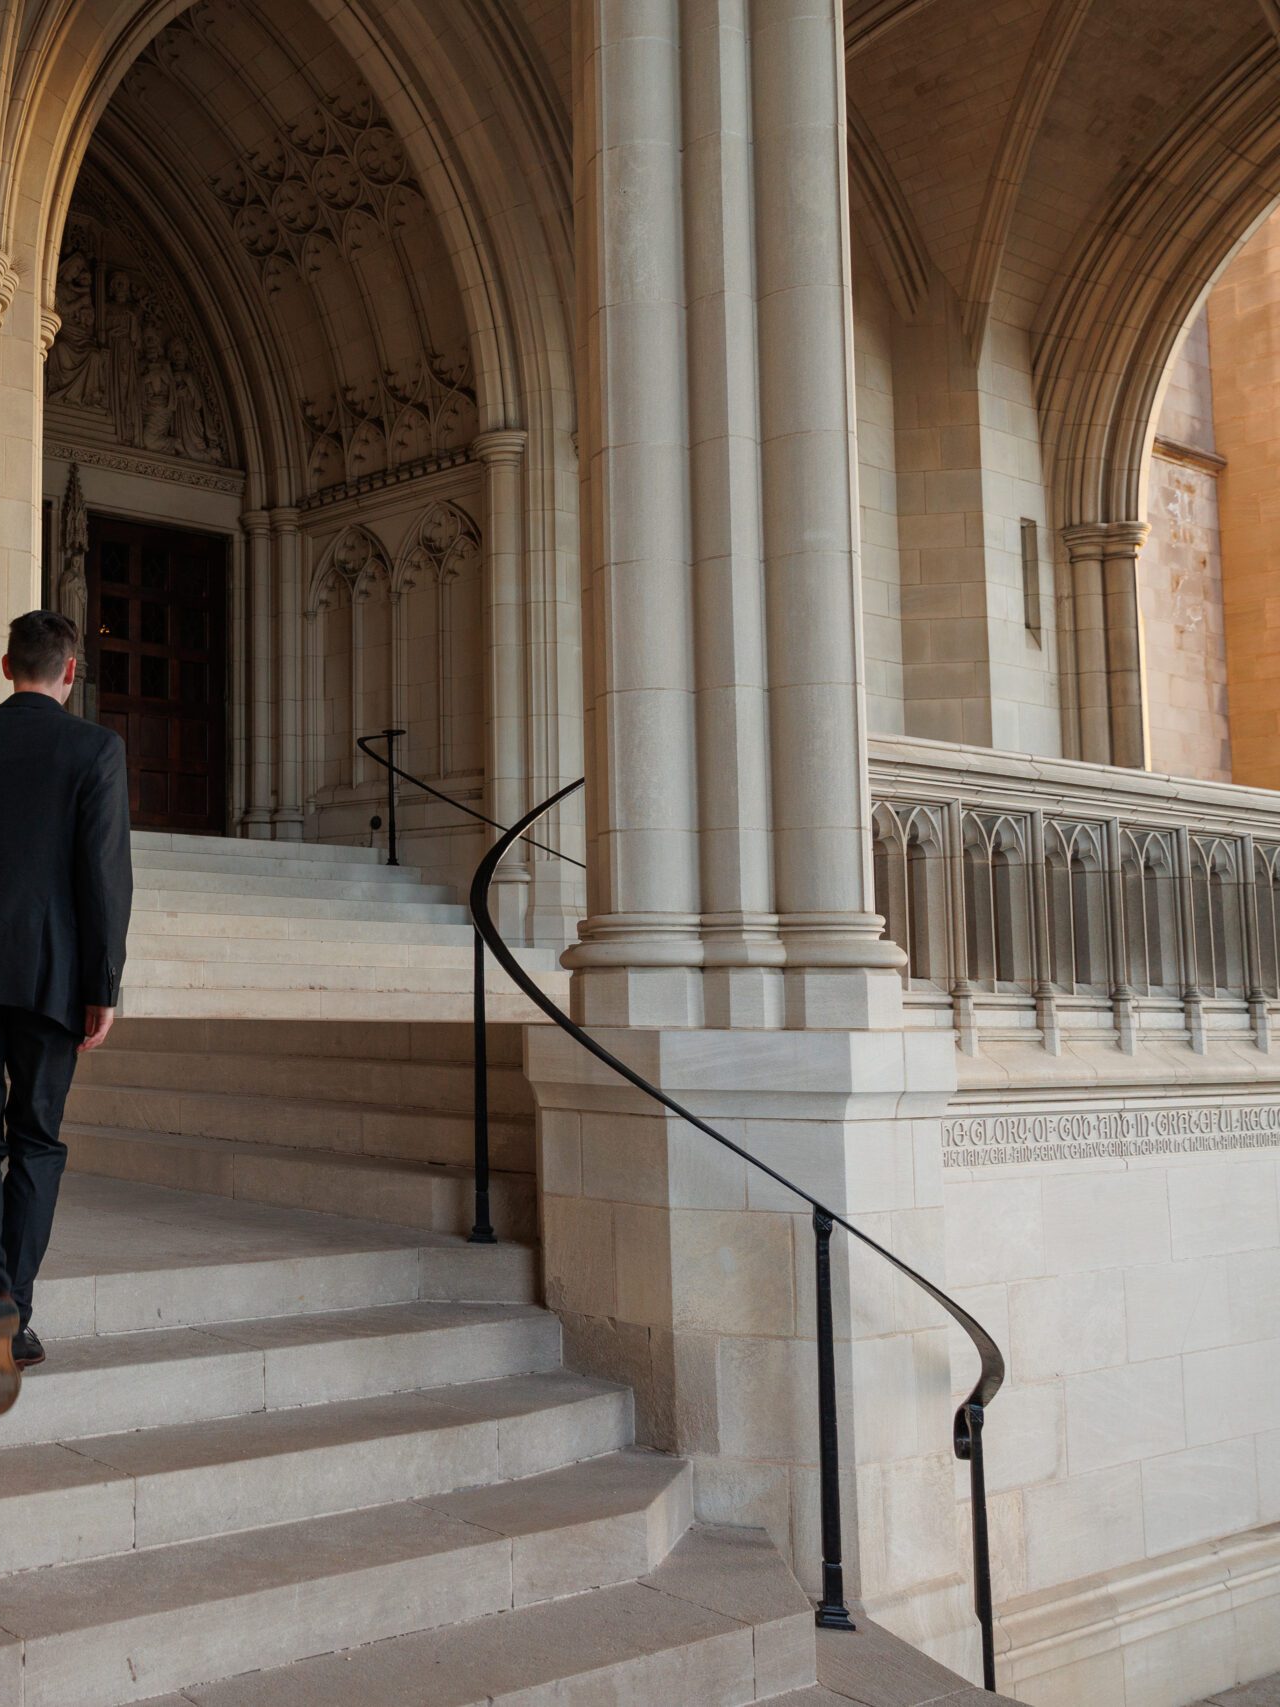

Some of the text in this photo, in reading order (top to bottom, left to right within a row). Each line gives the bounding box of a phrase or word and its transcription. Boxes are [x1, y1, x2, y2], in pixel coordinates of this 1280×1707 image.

[1033, 1116, 1054, 1143] OF
[1057, 1115, 1091, 1141] GOD
[1096, 1113, 1130, 1140] AND
[1135, 1112, 1149, 1138] IN
[1155, 1109, 1239, 1136] GRATEFUL
[1012, 1145, 1032, 1164] AND
[1033, 1142, 1077, 1162] SERVICE
